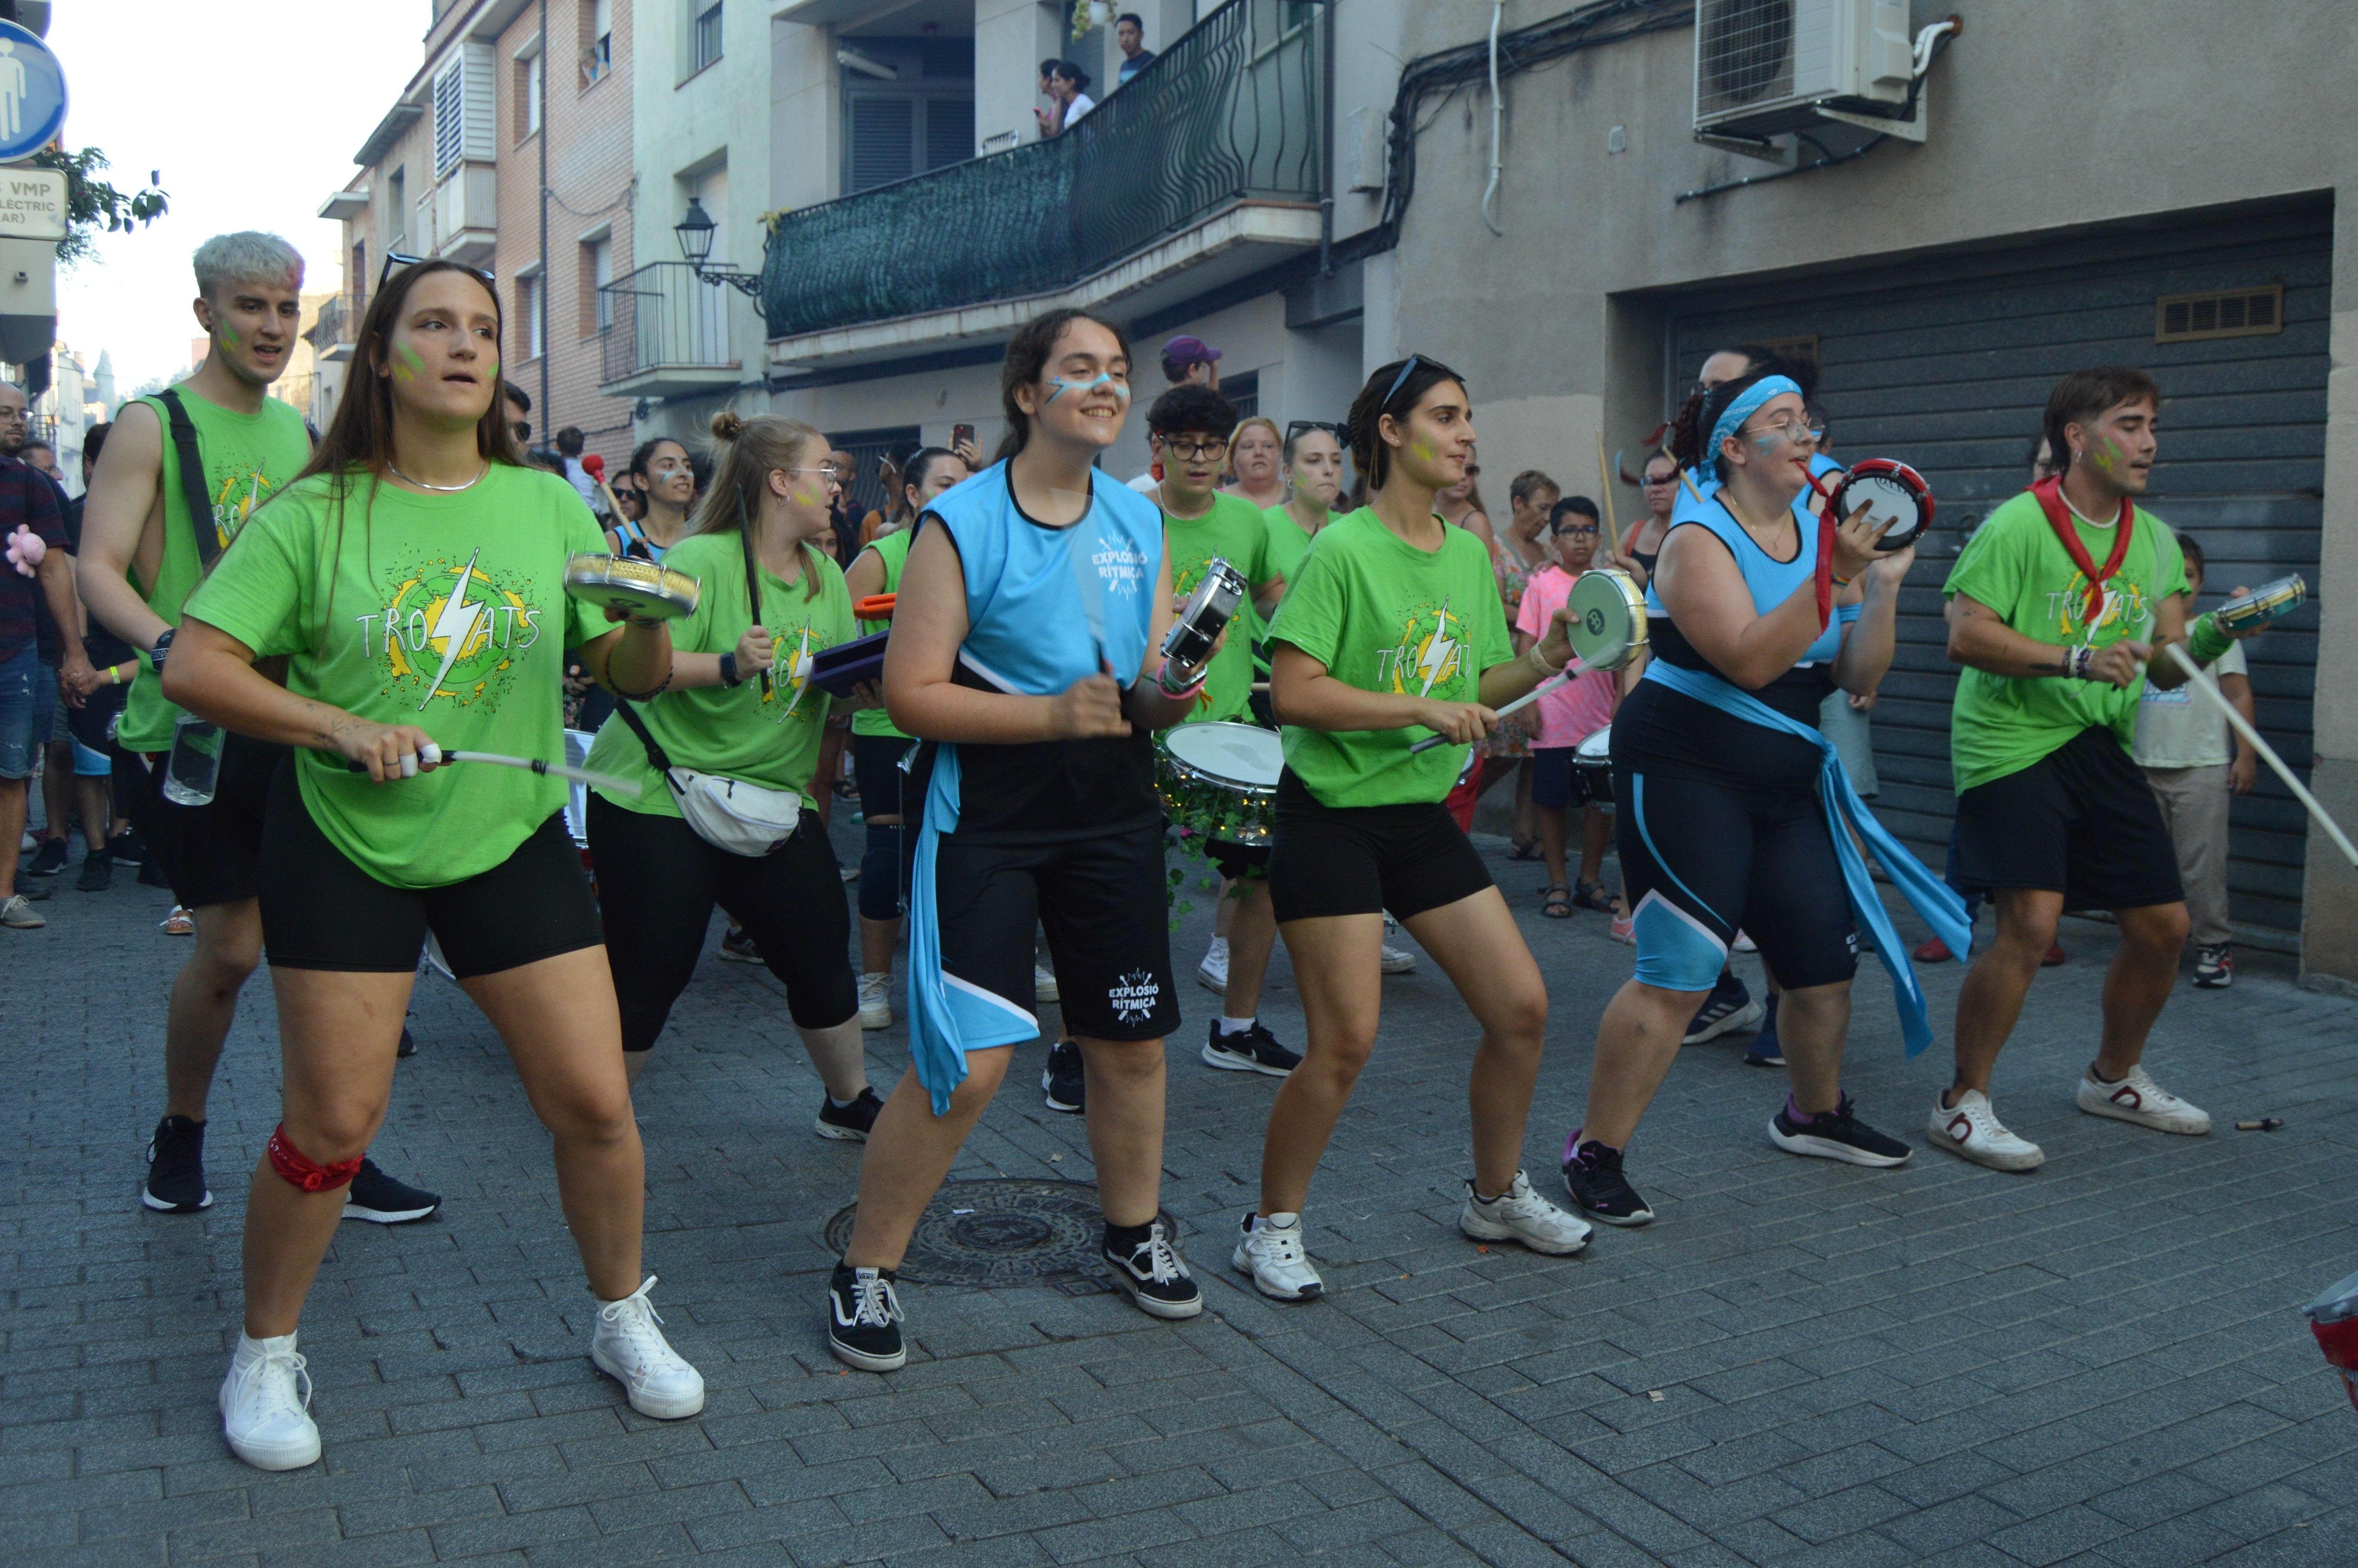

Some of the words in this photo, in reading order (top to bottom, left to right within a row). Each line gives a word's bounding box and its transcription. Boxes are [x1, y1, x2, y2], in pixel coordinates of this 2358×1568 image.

[11, 182, 51, 197] VMP
[1098, 564, 1144, 579] RÍTMICA
[1109, 983, 1159, 998] EXPLOSIÓ
[1112, 996, 1156, 1010] RÍTMICA
